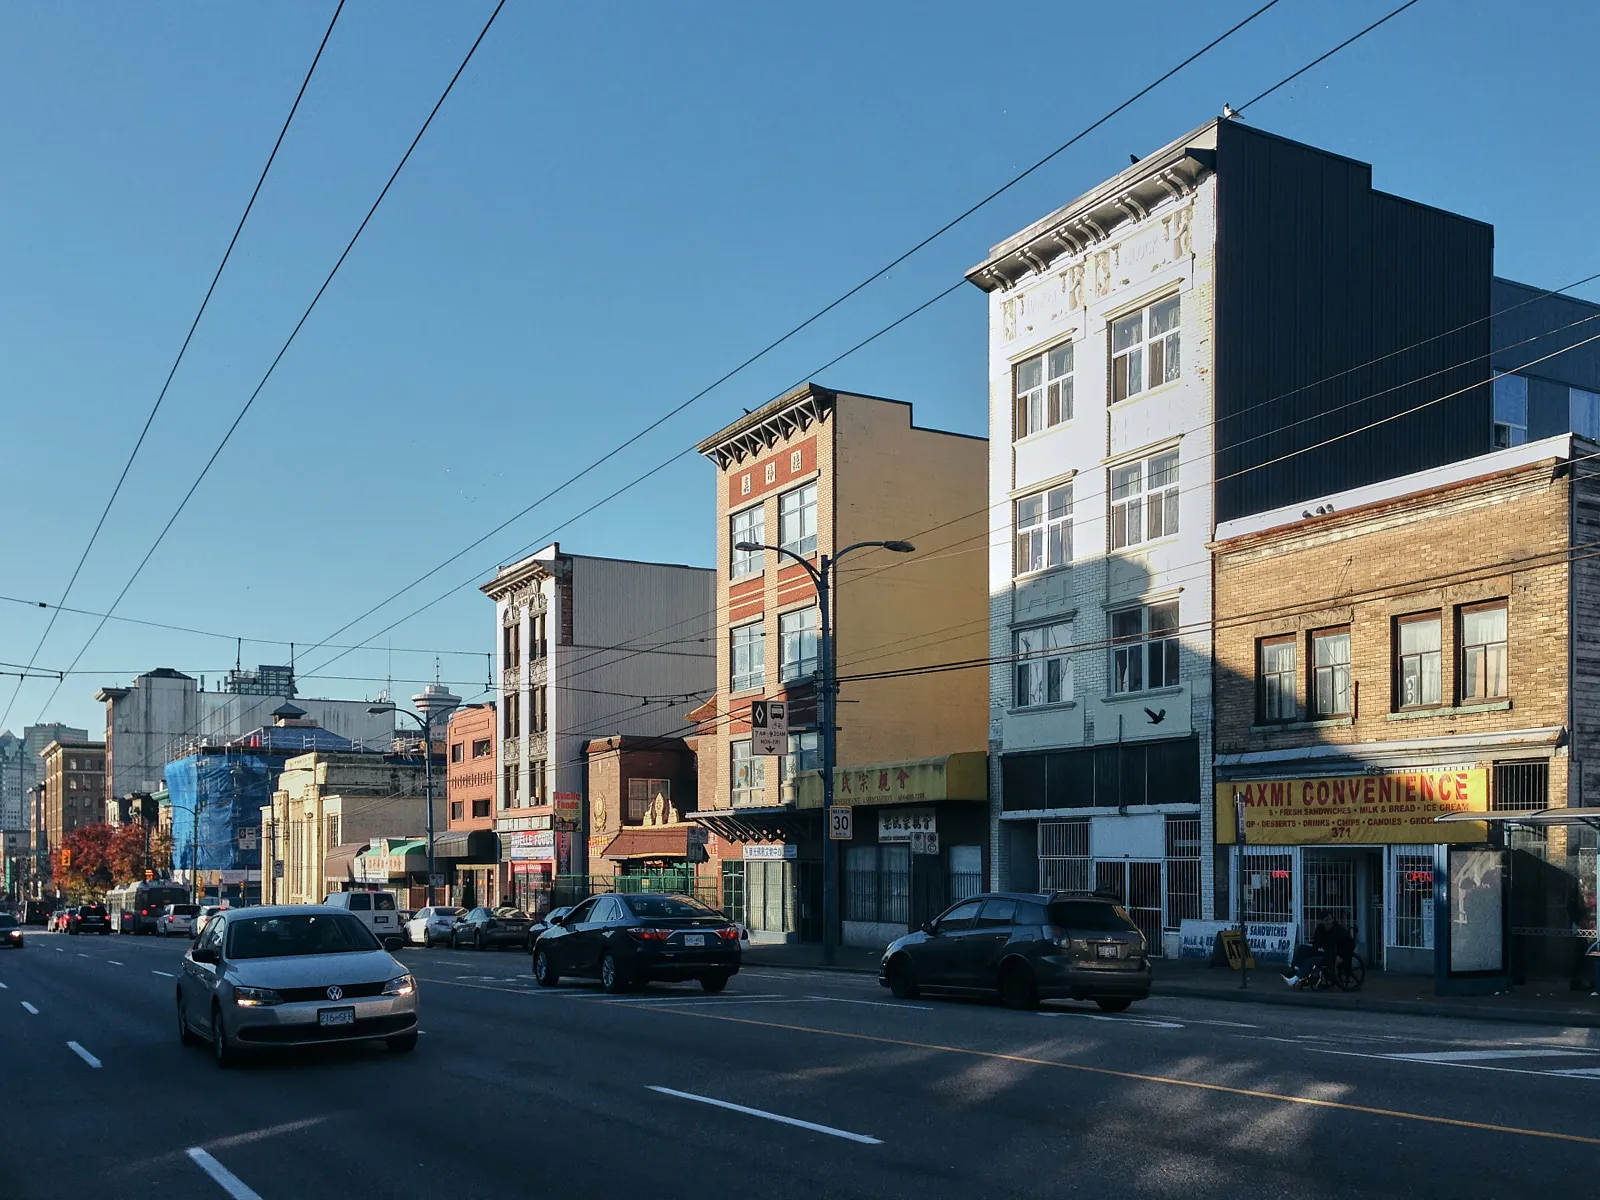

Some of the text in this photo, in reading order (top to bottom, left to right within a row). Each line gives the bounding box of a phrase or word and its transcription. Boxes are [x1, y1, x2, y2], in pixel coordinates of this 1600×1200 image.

[1302, 773, 1468, 805] CONVENIENCE
[1279, 808, 1302, 816] FRESH
[1304, 807, 1352, 816] SANDWICHES
[1359, 805, 1379, 814] MILK
[1381, 804, 1387, 813] &
[1389, 804, 1416, 813] BREAD
[1423, 803, 1437, 812] ICE
[1439, 803, 1469, 812] CREAM
[833, 815, 849, 830] 30
[1261, 820, 1296, 828] DESSERTS
[1303, 819, 1330, 827] DRINKS
[1337, 818, 1360, 826] CHIPS
[1367, 818, 1402, 826] CANDIES
[1331, 827, 1350, 838] 371
[1405, 871, 1433, 882] OPEN
[1250, 925, 1288, 937] SANDWICHES
